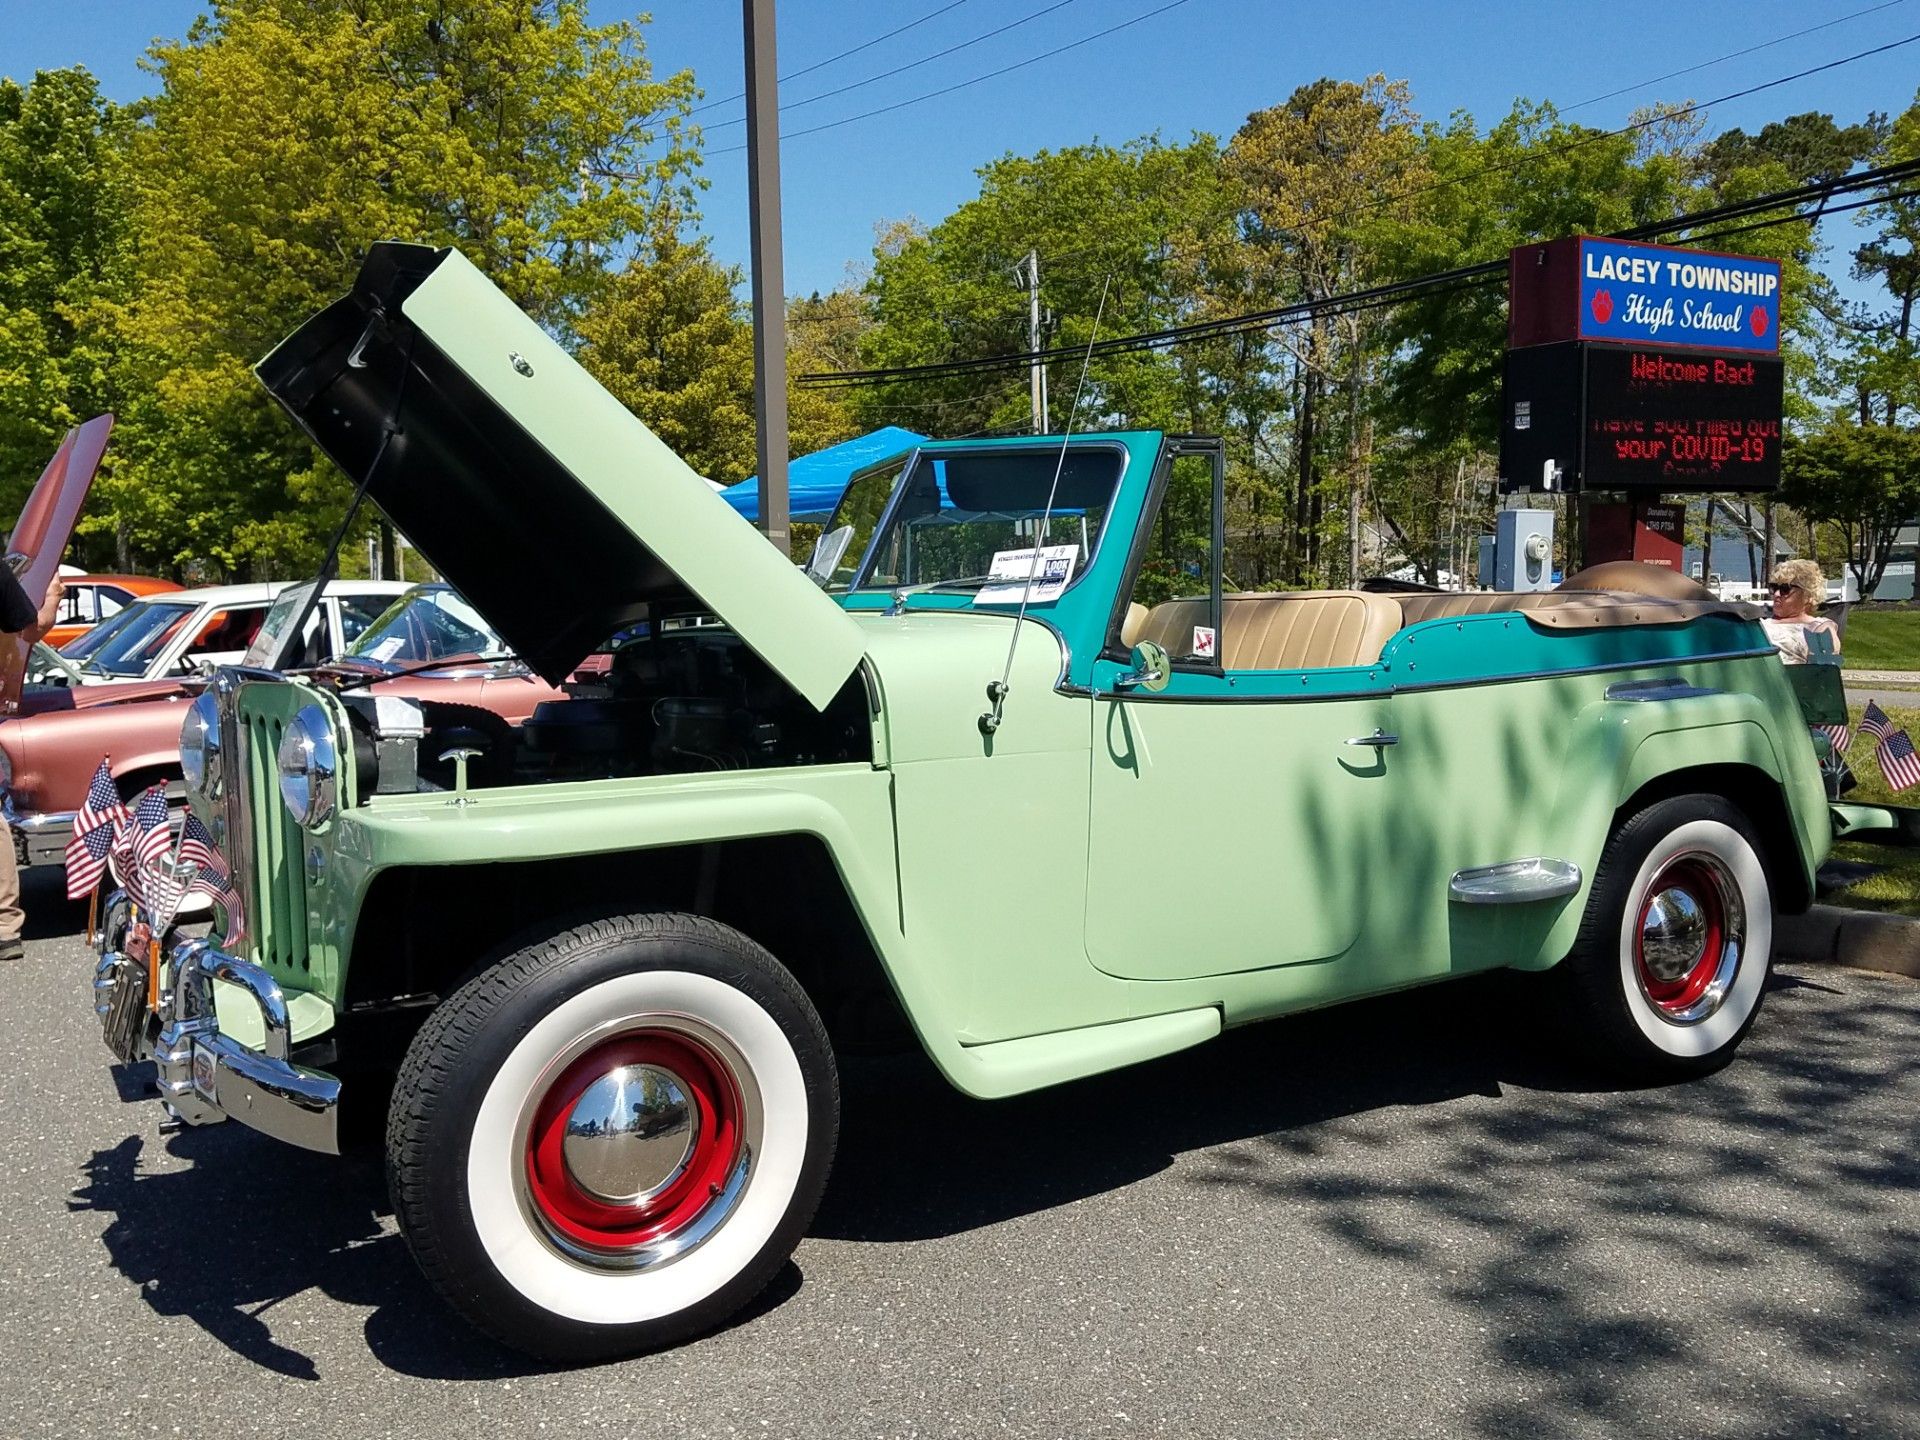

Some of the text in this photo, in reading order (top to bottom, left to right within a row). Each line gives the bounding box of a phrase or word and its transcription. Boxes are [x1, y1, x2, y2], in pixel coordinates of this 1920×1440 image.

[1586, 253, 1777, 297] LACEY TOWNSHIP
[1622, 293, 1743, 334] High School
[1631, 353, 1755, 385] Welcome Back
[1615, 435, 1764, 462] your COVID-19
[1647, 507, 1667, 517] Donated
[1046, 560, 1068, 571] LOOK
